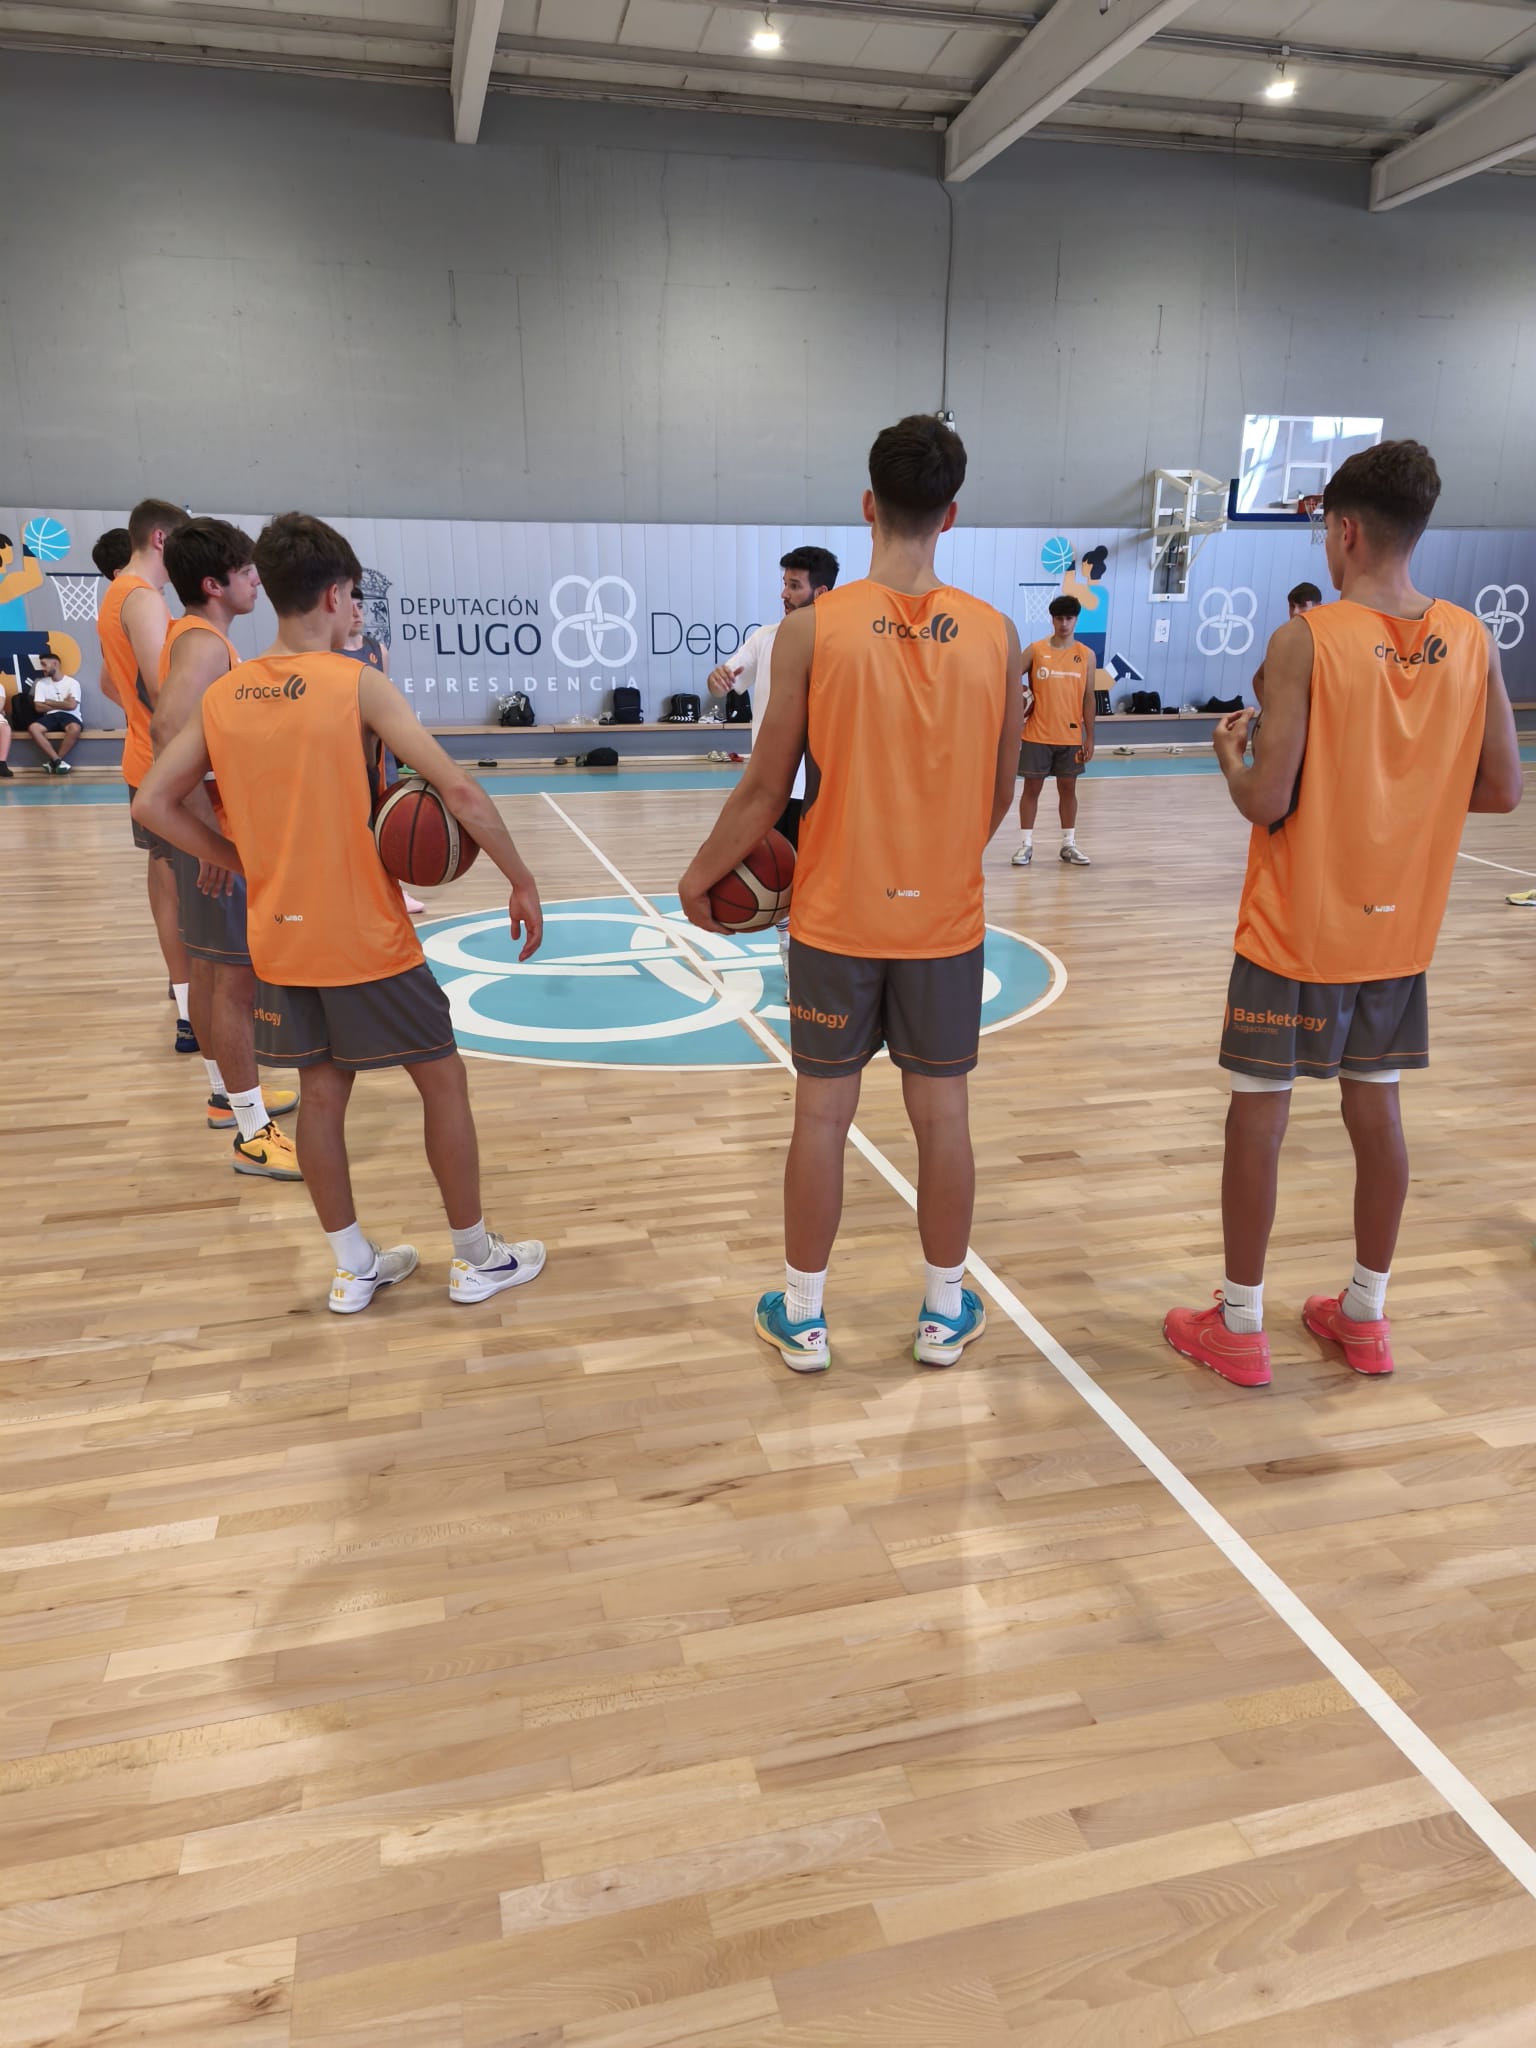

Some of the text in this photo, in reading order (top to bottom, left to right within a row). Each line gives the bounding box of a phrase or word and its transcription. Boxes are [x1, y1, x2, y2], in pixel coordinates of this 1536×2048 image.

[400, 595, 539, 616] DEPUTACIÓN
[872, 615, 931, 640] droce
[402, 623, 542, 656] DE LUGO
[234, 684, 281, 700] droce
[403, 675, 640, 693] EPRESIDENCIA
